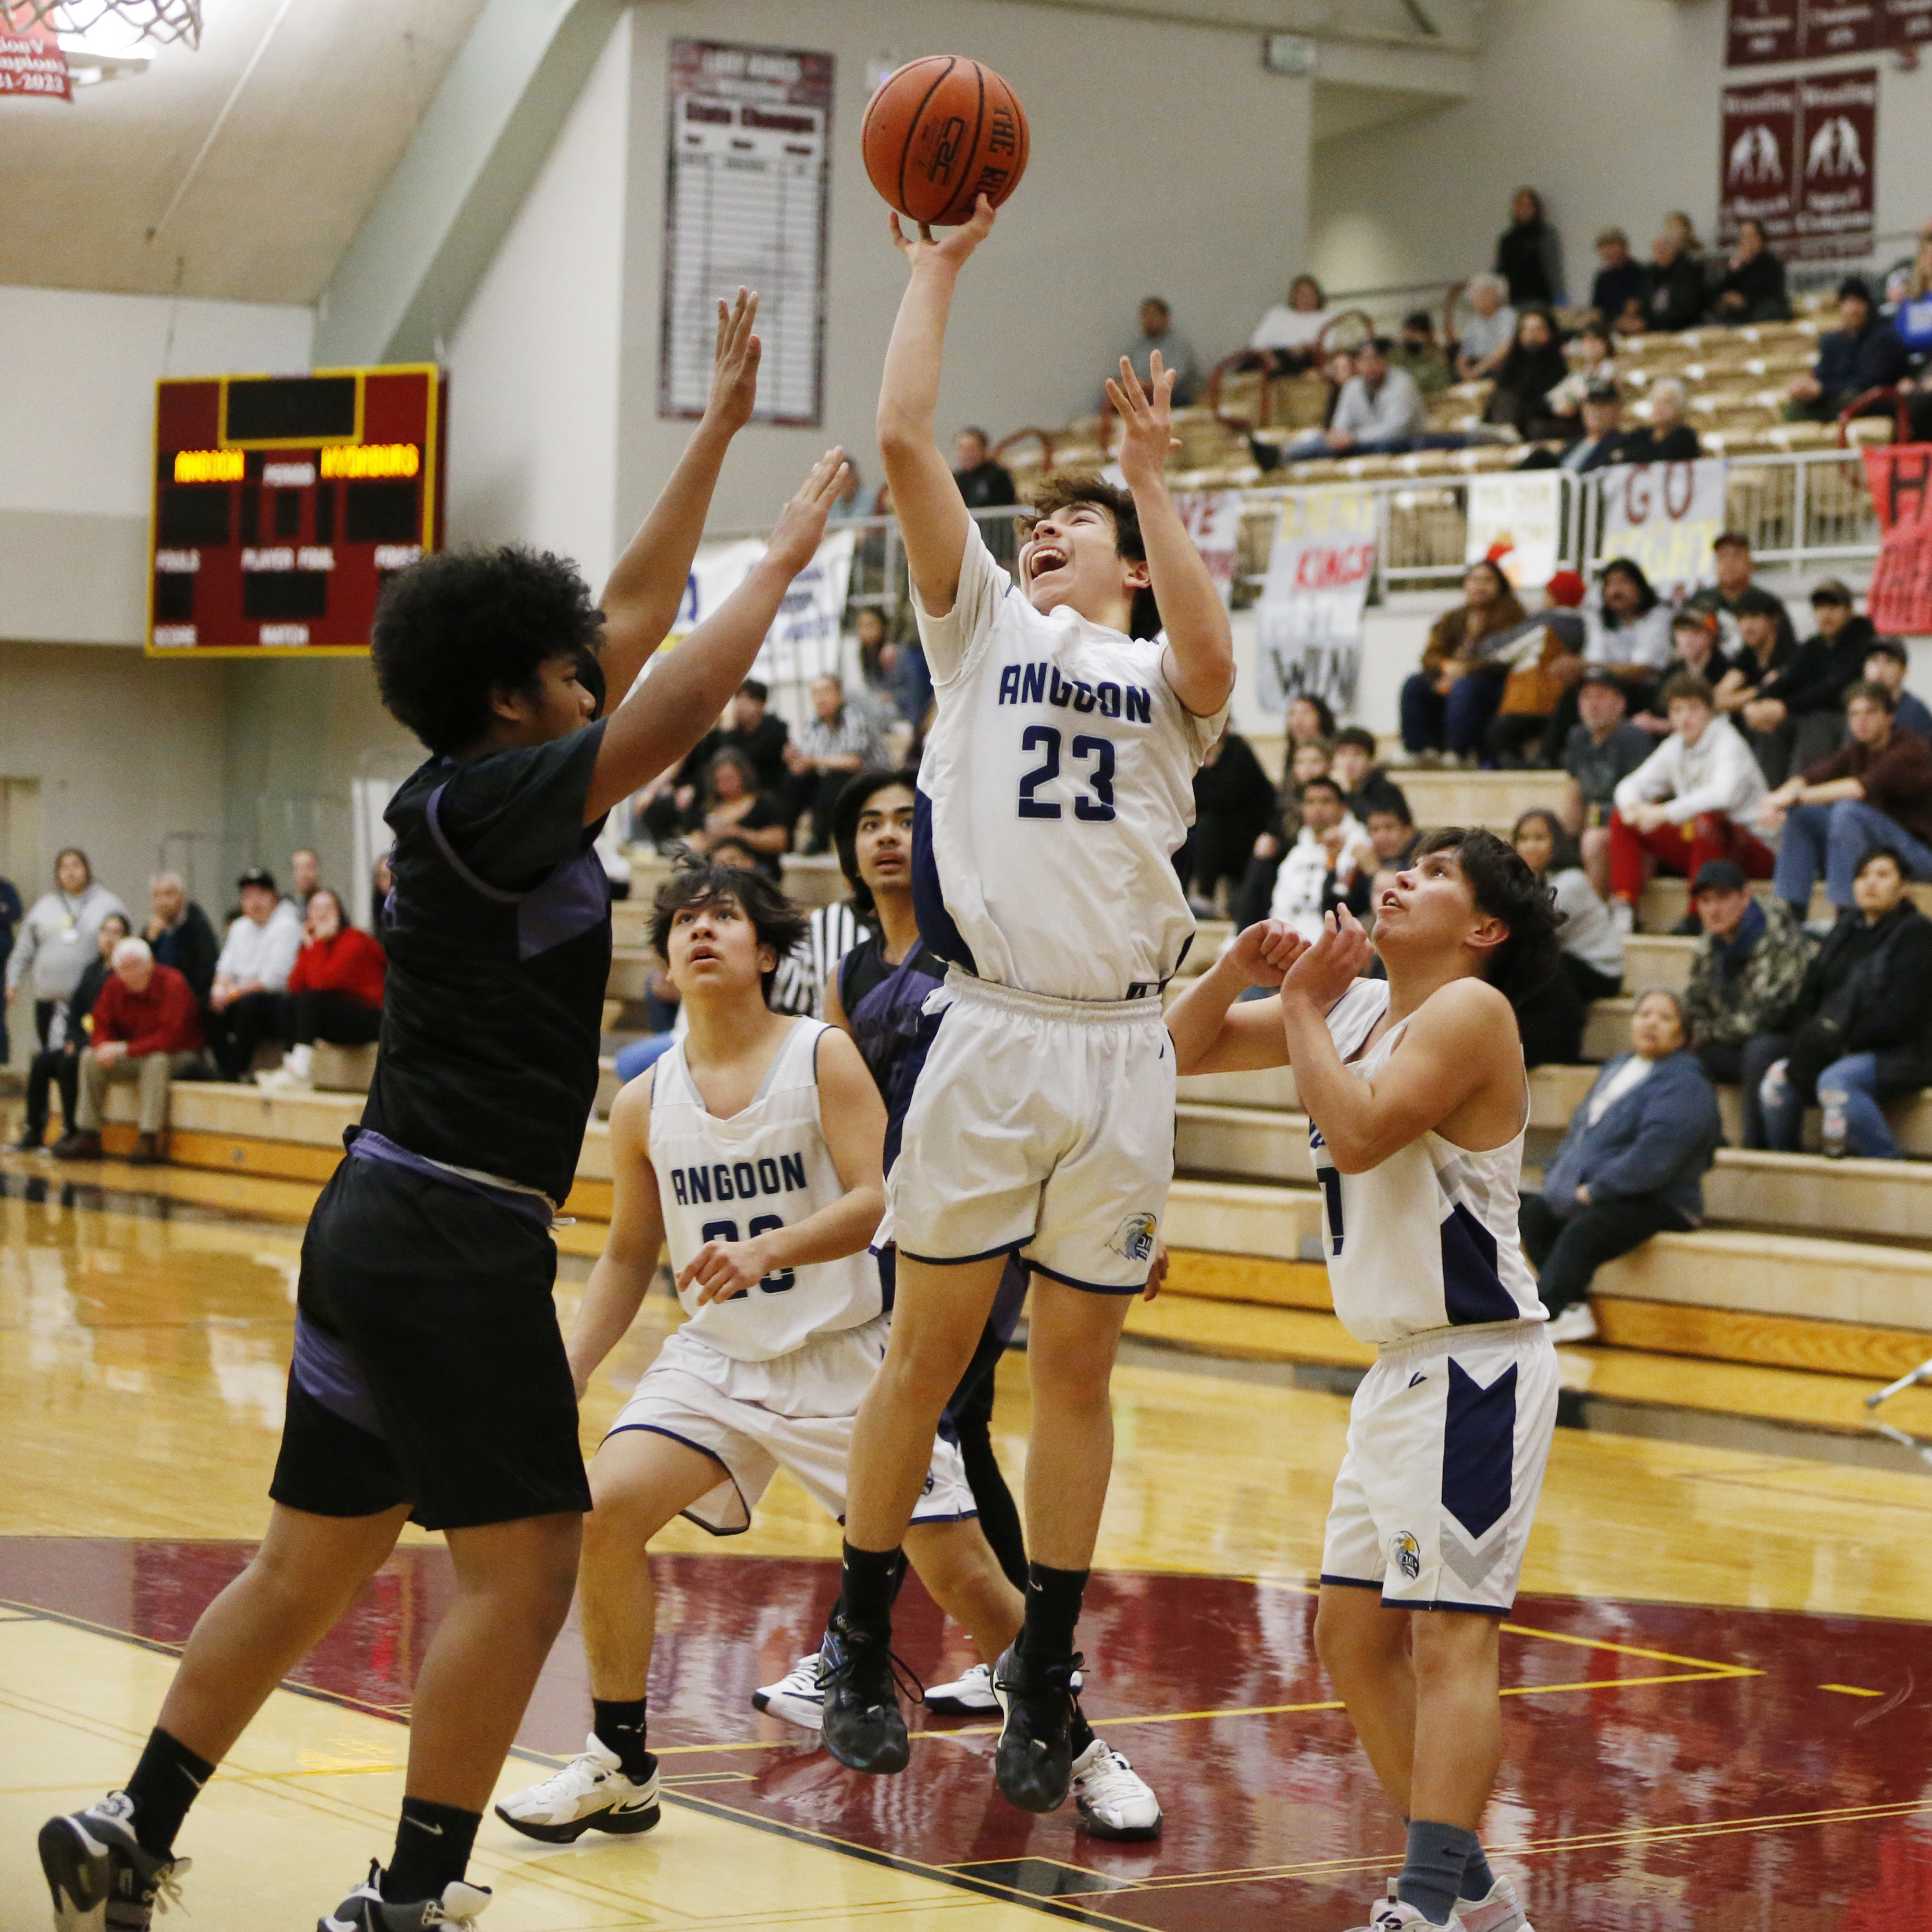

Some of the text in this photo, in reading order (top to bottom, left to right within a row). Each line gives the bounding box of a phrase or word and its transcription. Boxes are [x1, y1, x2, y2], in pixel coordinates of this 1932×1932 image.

[1624, 460, 1694, 525] GO
[998, 662, 1152, 724] ANGOON
[1017, 724, 1117, 822] 23
[671, 1152, 807, 1205] ANGOON
